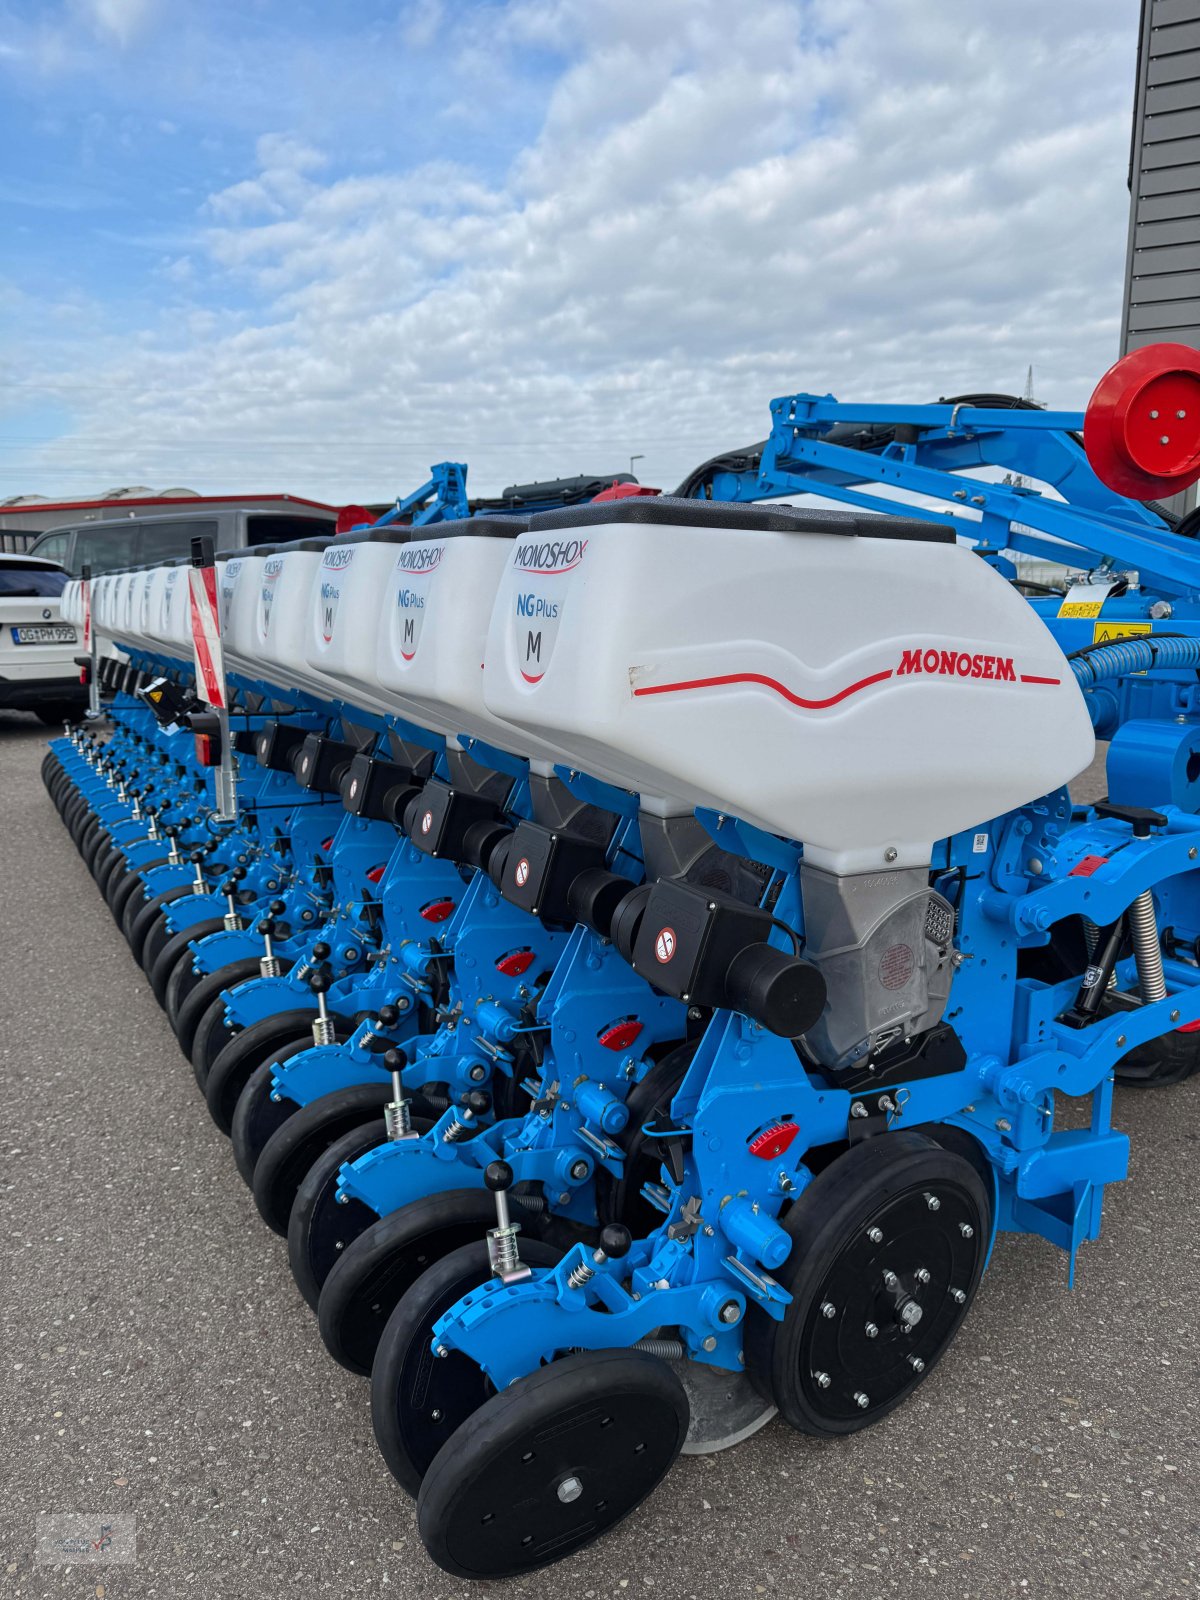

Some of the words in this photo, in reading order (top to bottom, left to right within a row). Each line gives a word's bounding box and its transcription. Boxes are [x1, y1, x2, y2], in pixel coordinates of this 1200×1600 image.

[397, 547, 445, 570] MONOSHOX
[514, 540, 589, 568] MONOSHOX
[325, 606, 333, 629] M
[516, 593, 535, 616] NG
[536, 598, 558, 618] Plus
[404, 618, 414, 644] M
[526, 630, 542, 663] M
[896, 648, 1017, 682] MONOSEM
